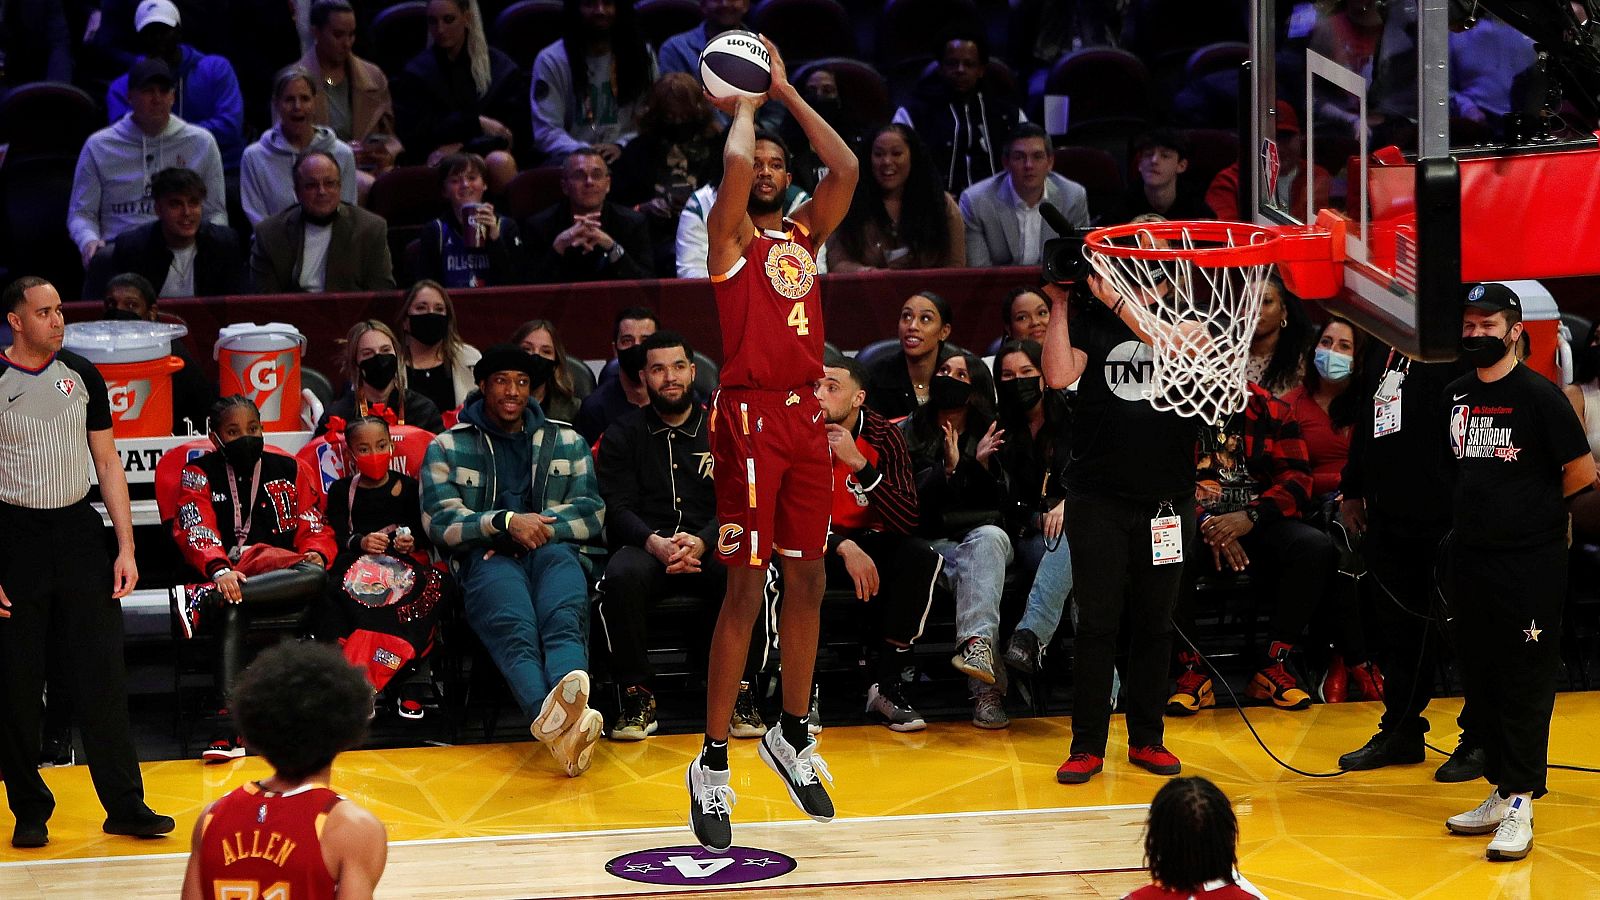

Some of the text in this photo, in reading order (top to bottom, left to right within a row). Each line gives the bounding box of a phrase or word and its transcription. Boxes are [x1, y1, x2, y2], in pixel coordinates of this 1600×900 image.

[787, 301, 810, 336] 4
[250, 360, 277, 391] G
[108, 386, 129, 413] G
[1468, 428, 1512, 446] SATURDAY
[1470, 417, 1494, 428] ALL STAR
[117, 449, 163, 472] AT
[264, 479, 298, 534] D
[717, 523, 744, 555] C
[222, 830, 297, 868] ALLEN
[661, 855, 736, 878] 4
